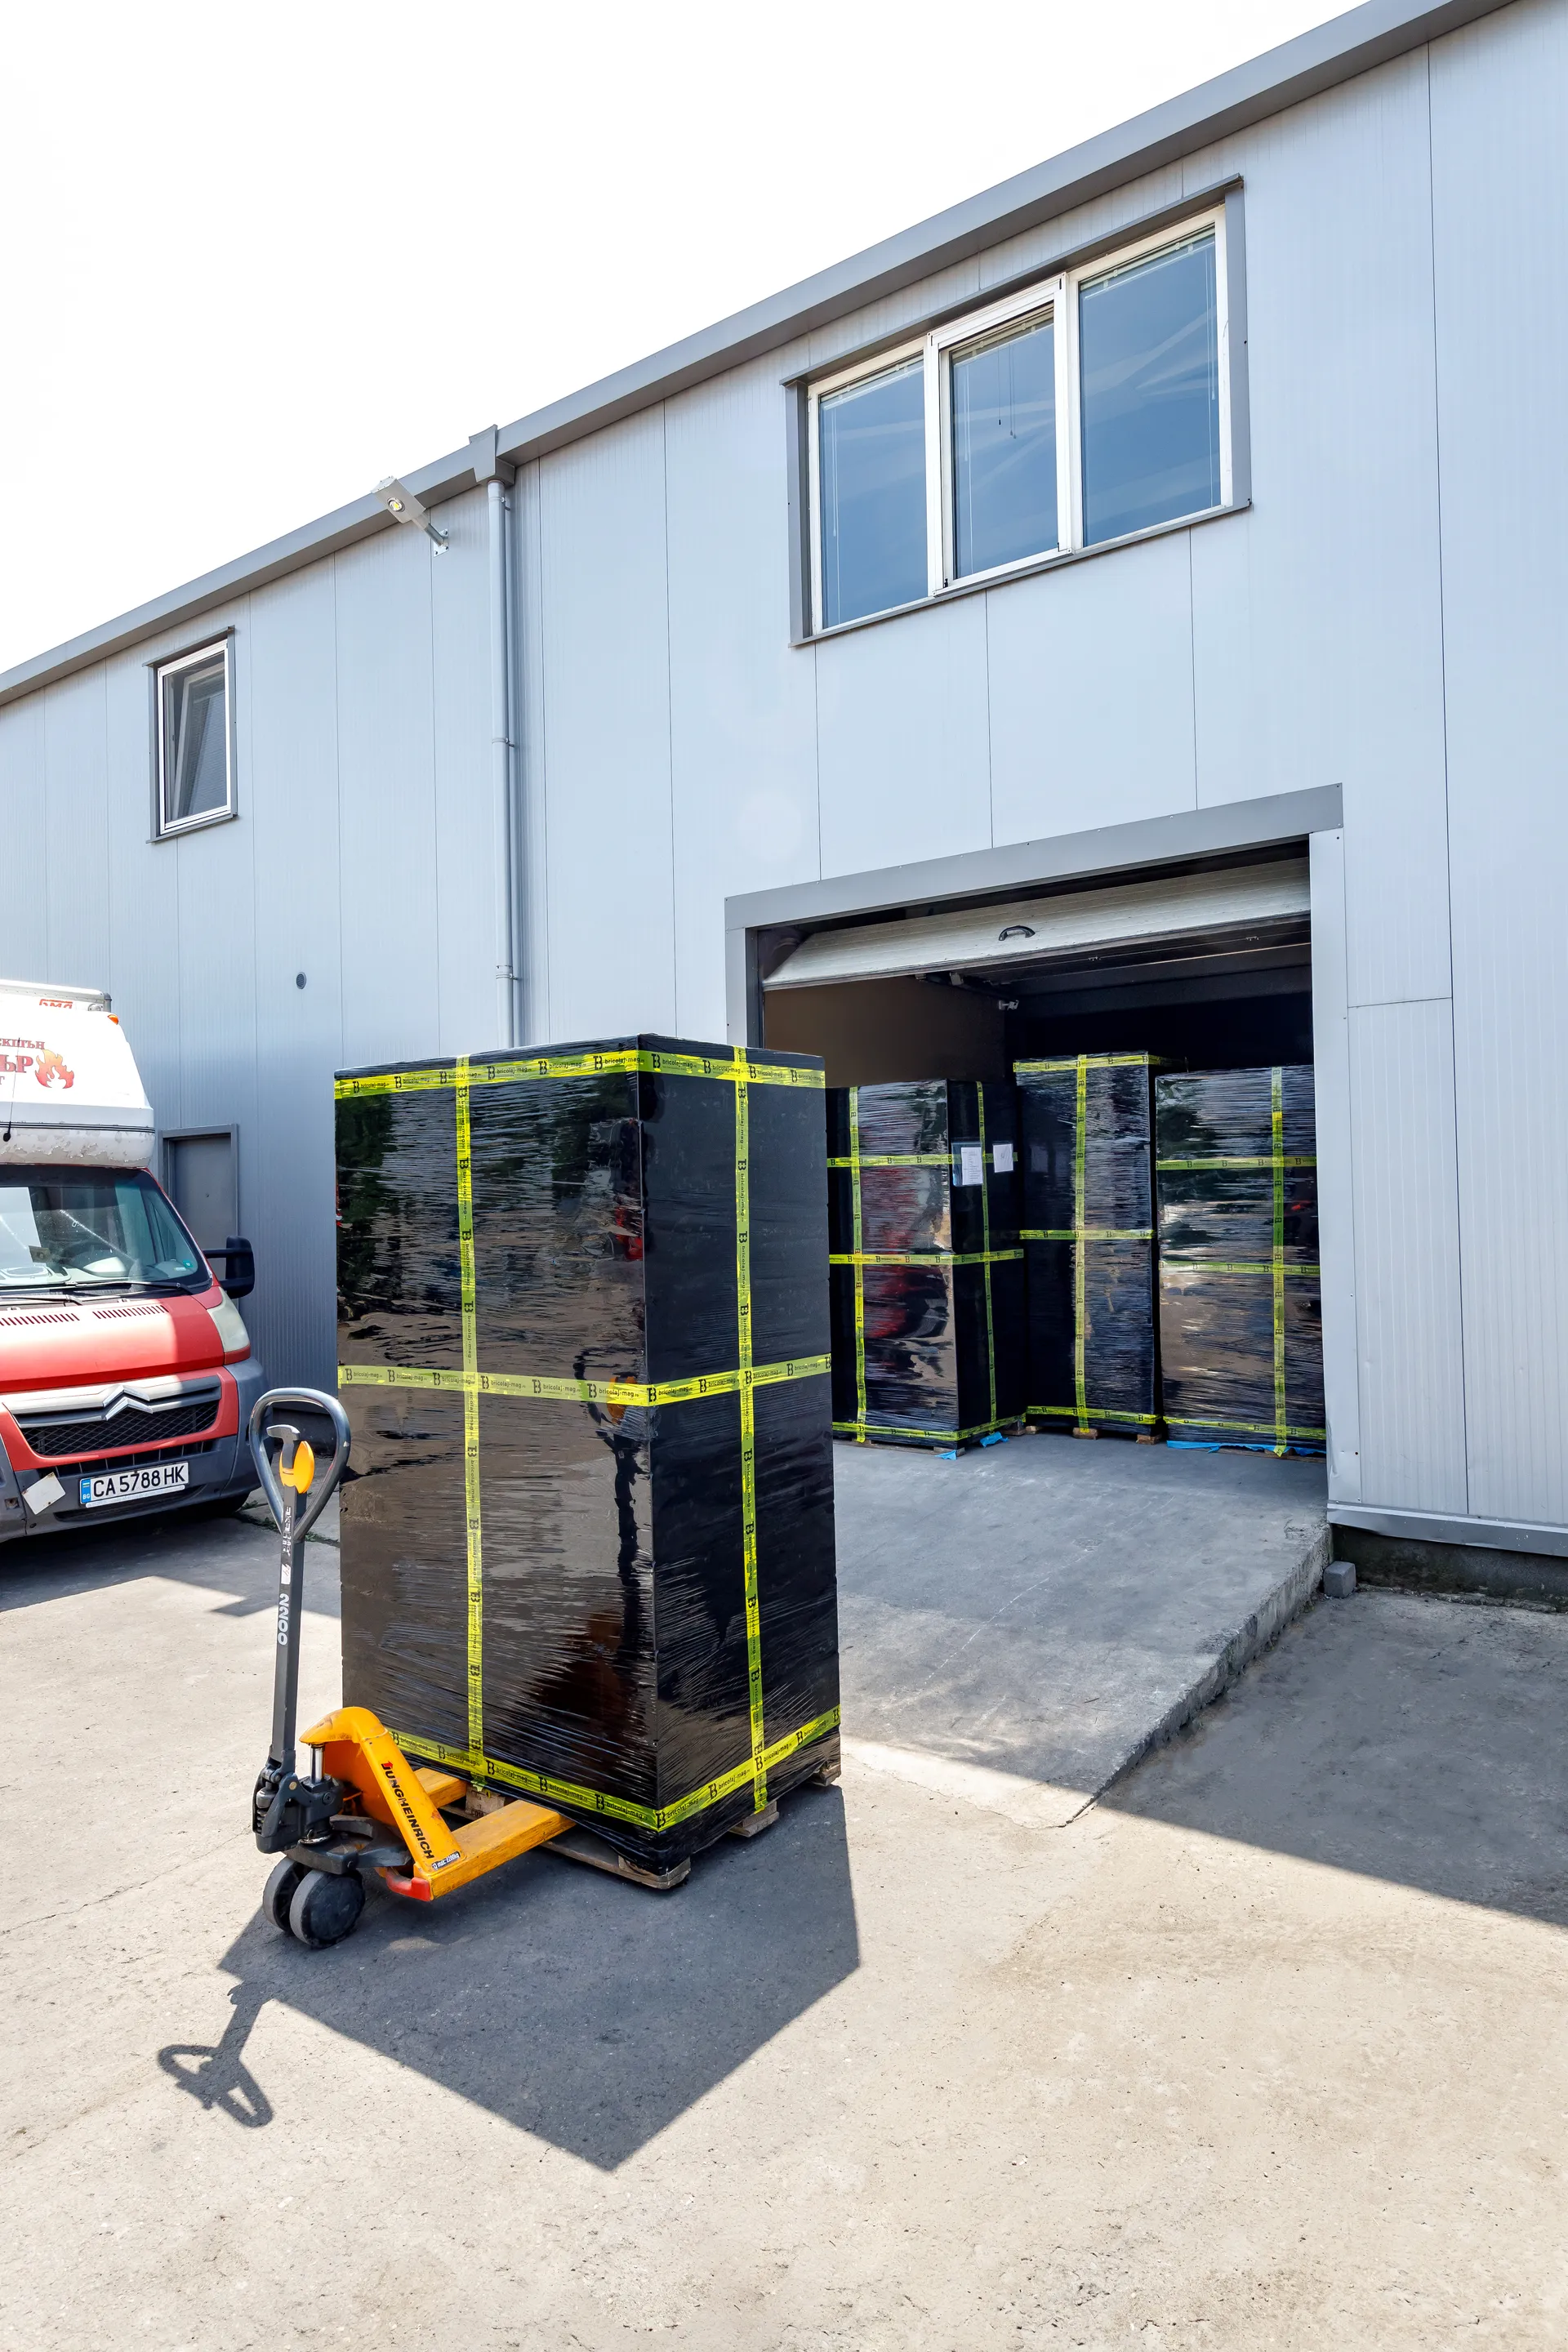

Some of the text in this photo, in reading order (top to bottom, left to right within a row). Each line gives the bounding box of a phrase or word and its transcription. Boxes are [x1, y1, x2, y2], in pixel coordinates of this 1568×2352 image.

[94, 1478, 116, 1497] CA
[120, 1470, 160, 1492] 5788
[164, 1465, 185, 1485] HK
[278, 1593, 289, 1646] 2200
[381, 1761, 434, 1860] JUNGHEINRICH
